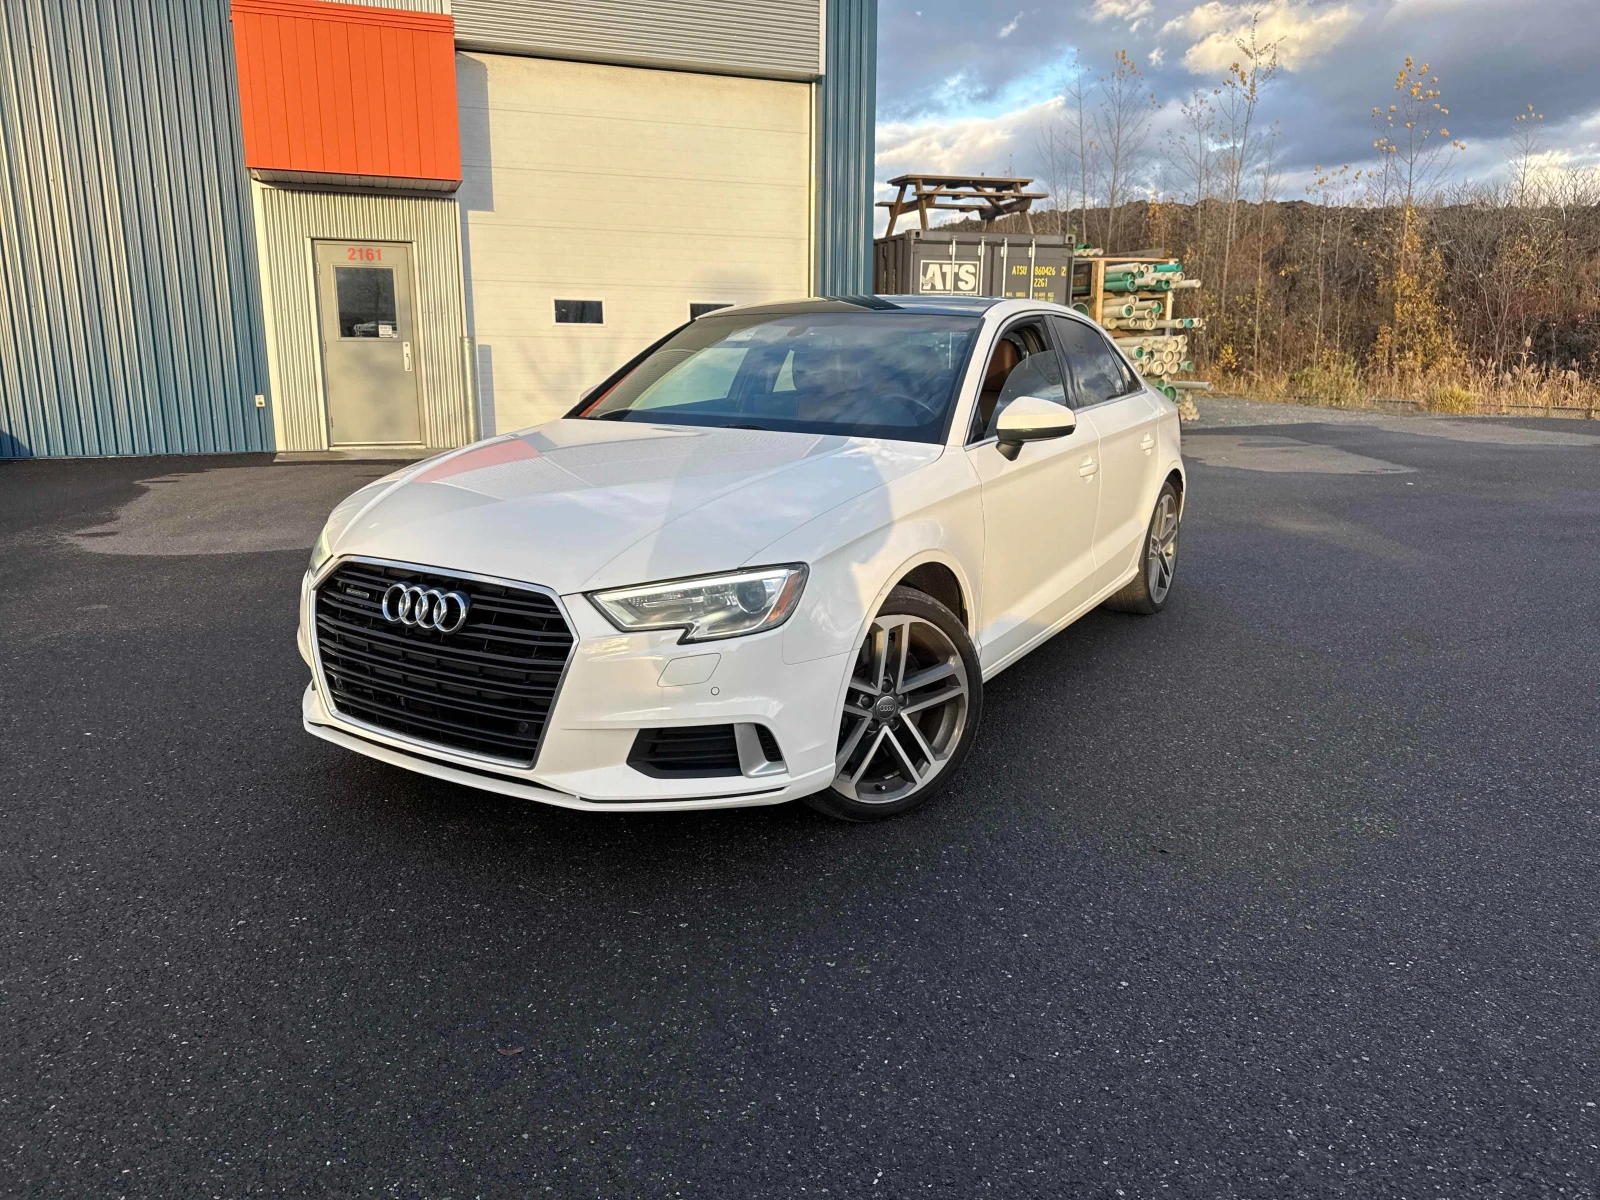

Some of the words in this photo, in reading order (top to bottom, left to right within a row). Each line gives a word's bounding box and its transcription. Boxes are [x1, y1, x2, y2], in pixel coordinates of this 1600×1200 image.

[347, 247, 382, 261] 2161
[1012, 265, 1028, 275] ATSU
[1034, 266, 1056, 276] 860426
[1061, 266, 1067, 276] 2
[923, 264, 976, 291] ATS
[1034, 278, 1048, 287] 22G1
